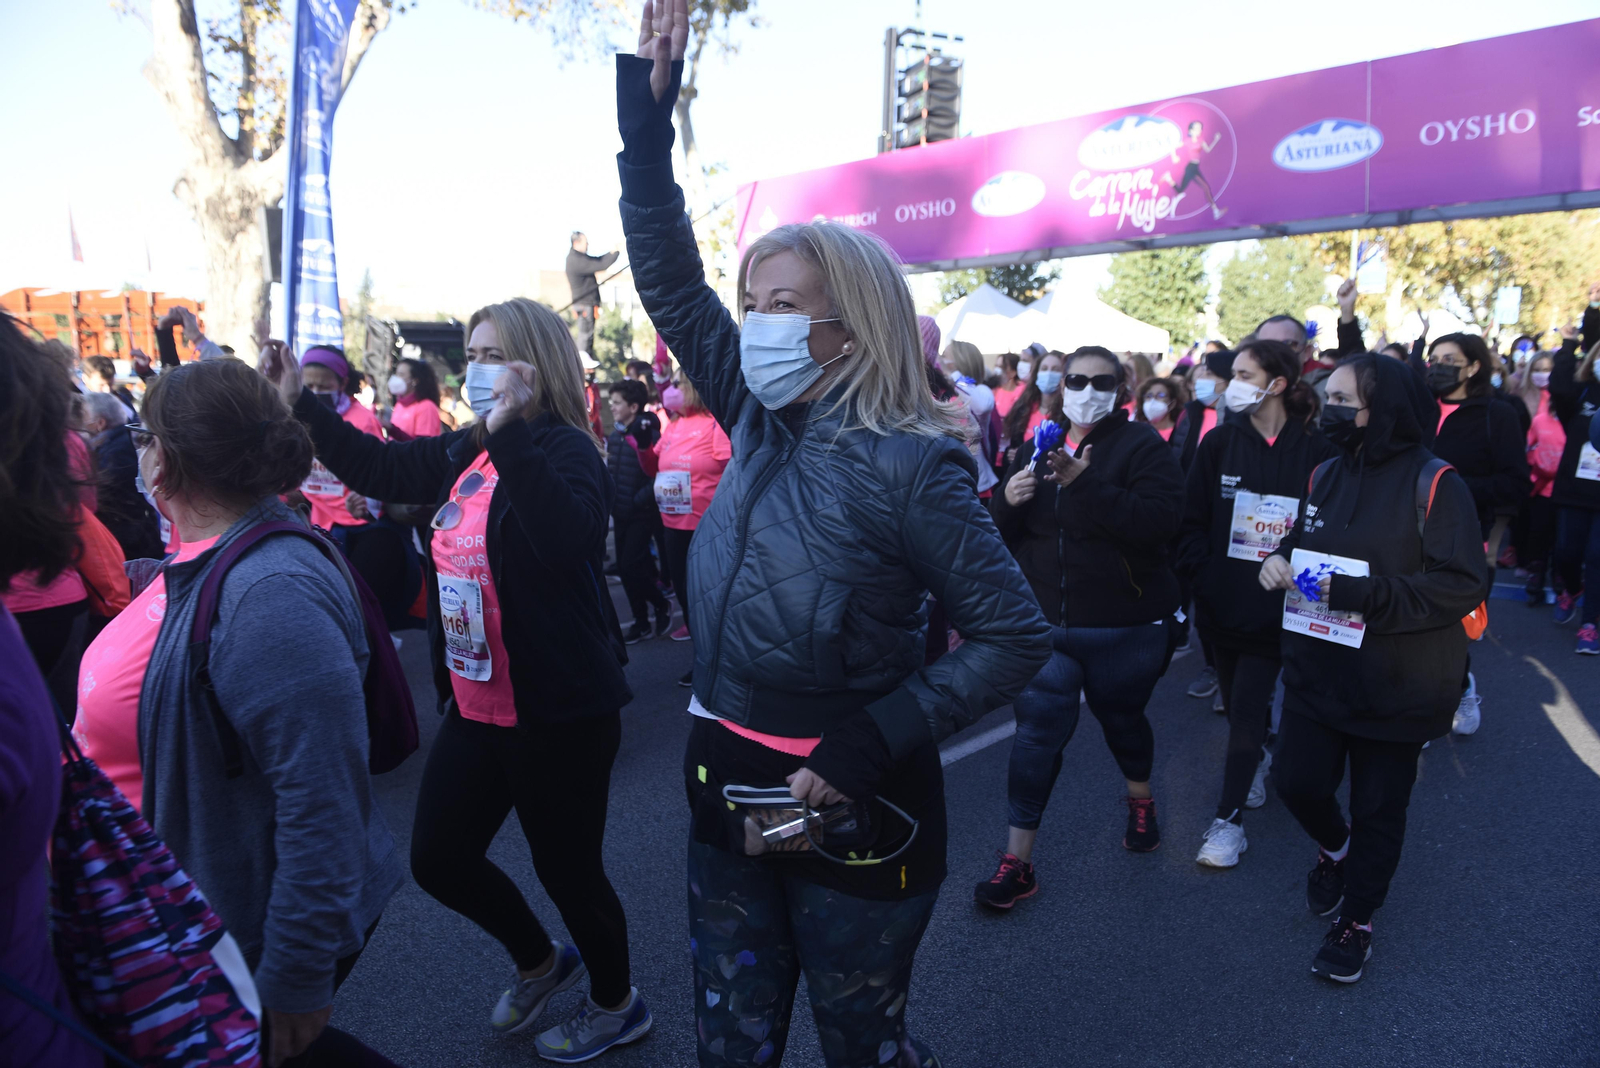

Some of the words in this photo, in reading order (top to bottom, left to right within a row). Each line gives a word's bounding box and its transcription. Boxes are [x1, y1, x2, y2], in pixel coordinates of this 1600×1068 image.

[1419, 108, 1536, 146] OYSHO
[1281, 138, 1373, 164] ASTURIANA
[1069, 168, 1154, 200] Carrera
[894, 197, 956, 223] OYSHO
[1116, 185, 1187, 233] Mujer
[663, 488, 679, 497] 016
[1255, 521, 1284, 536] 016
[456, 535, 485, 549] POR
[450, 554, 486, 568] TODAS
[443, 614, 464, 636] 016
[1297, 609, 1318, 618] CARRERA
[1332, 617, 1350, 626] MUJER
